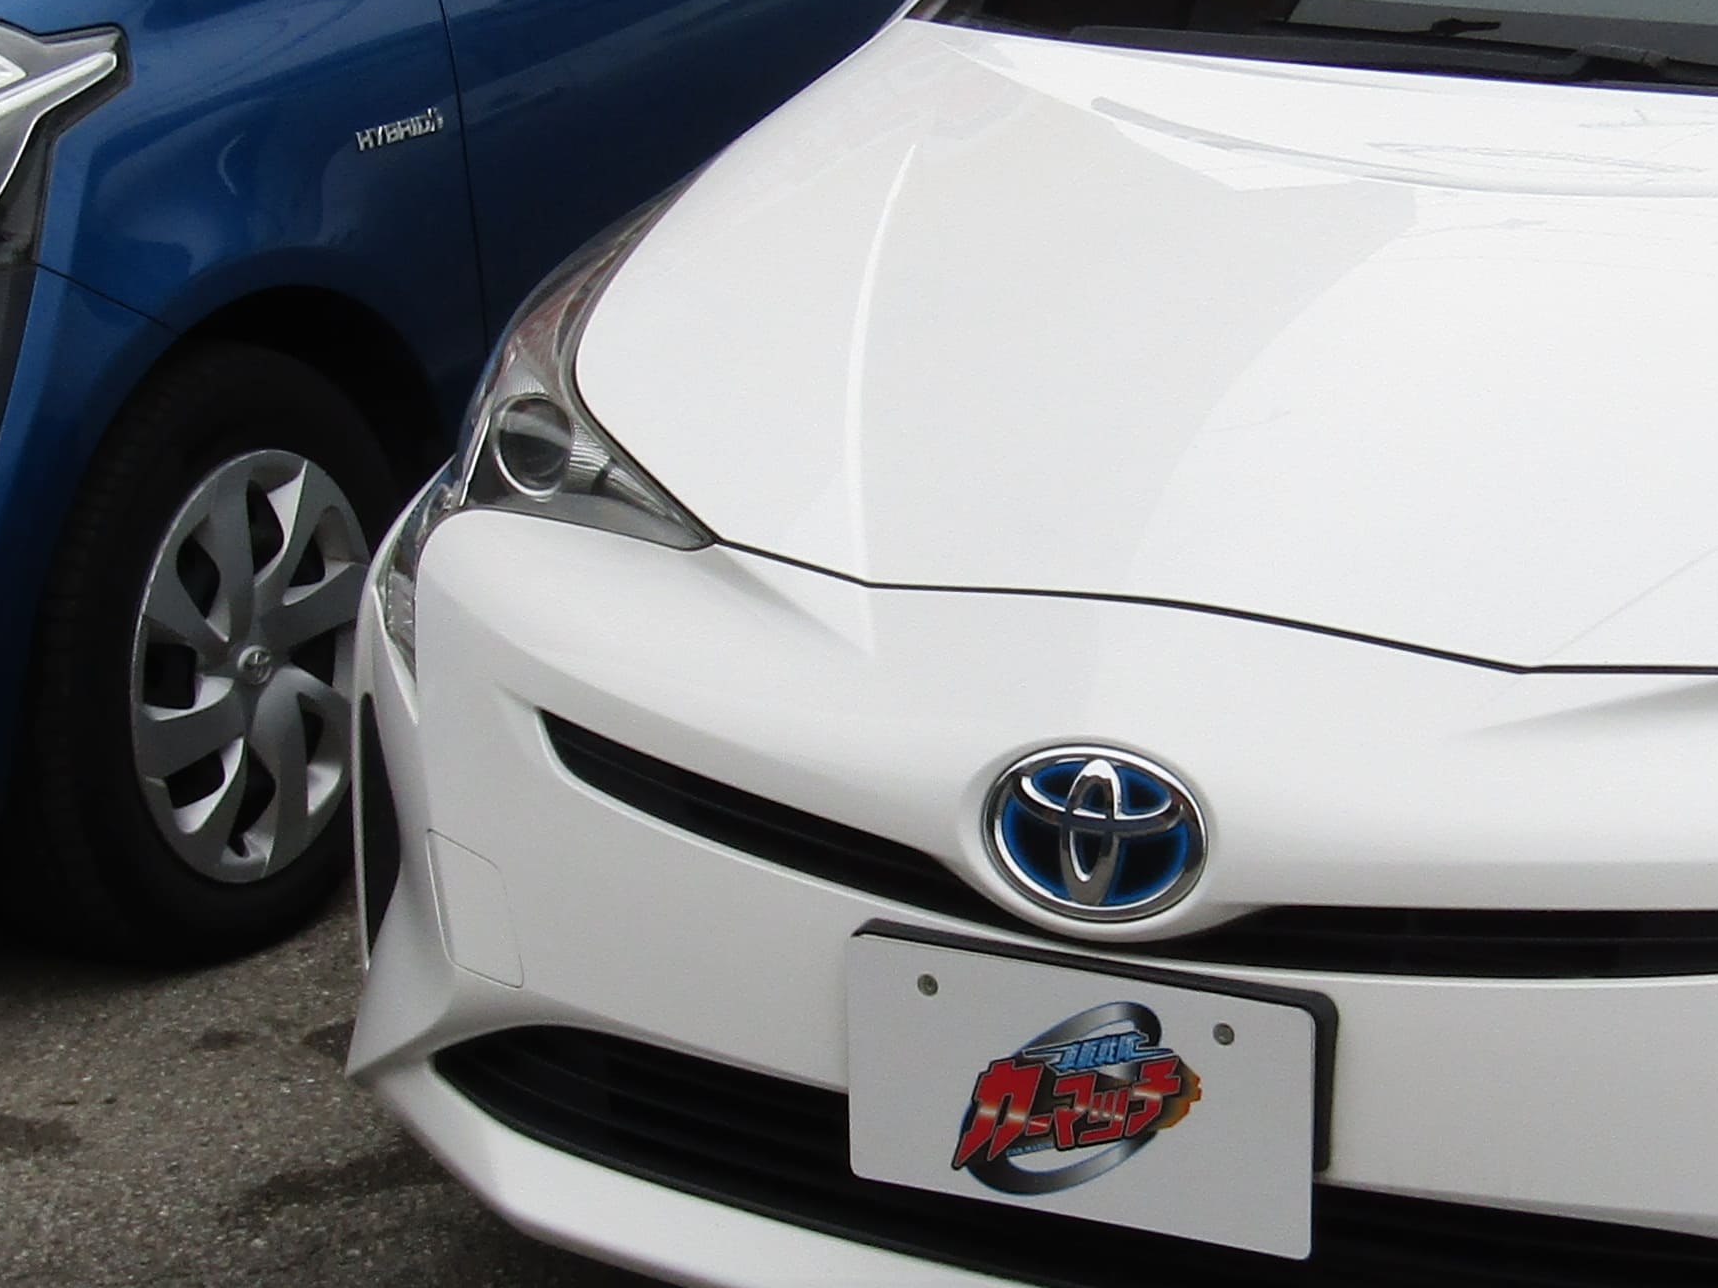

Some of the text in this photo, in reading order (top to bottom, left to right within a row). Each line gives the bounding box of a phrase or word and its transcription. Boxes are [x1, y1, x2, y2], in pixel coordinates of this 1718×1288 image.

[950, 1058, 1182, 1170] カーマッチ
